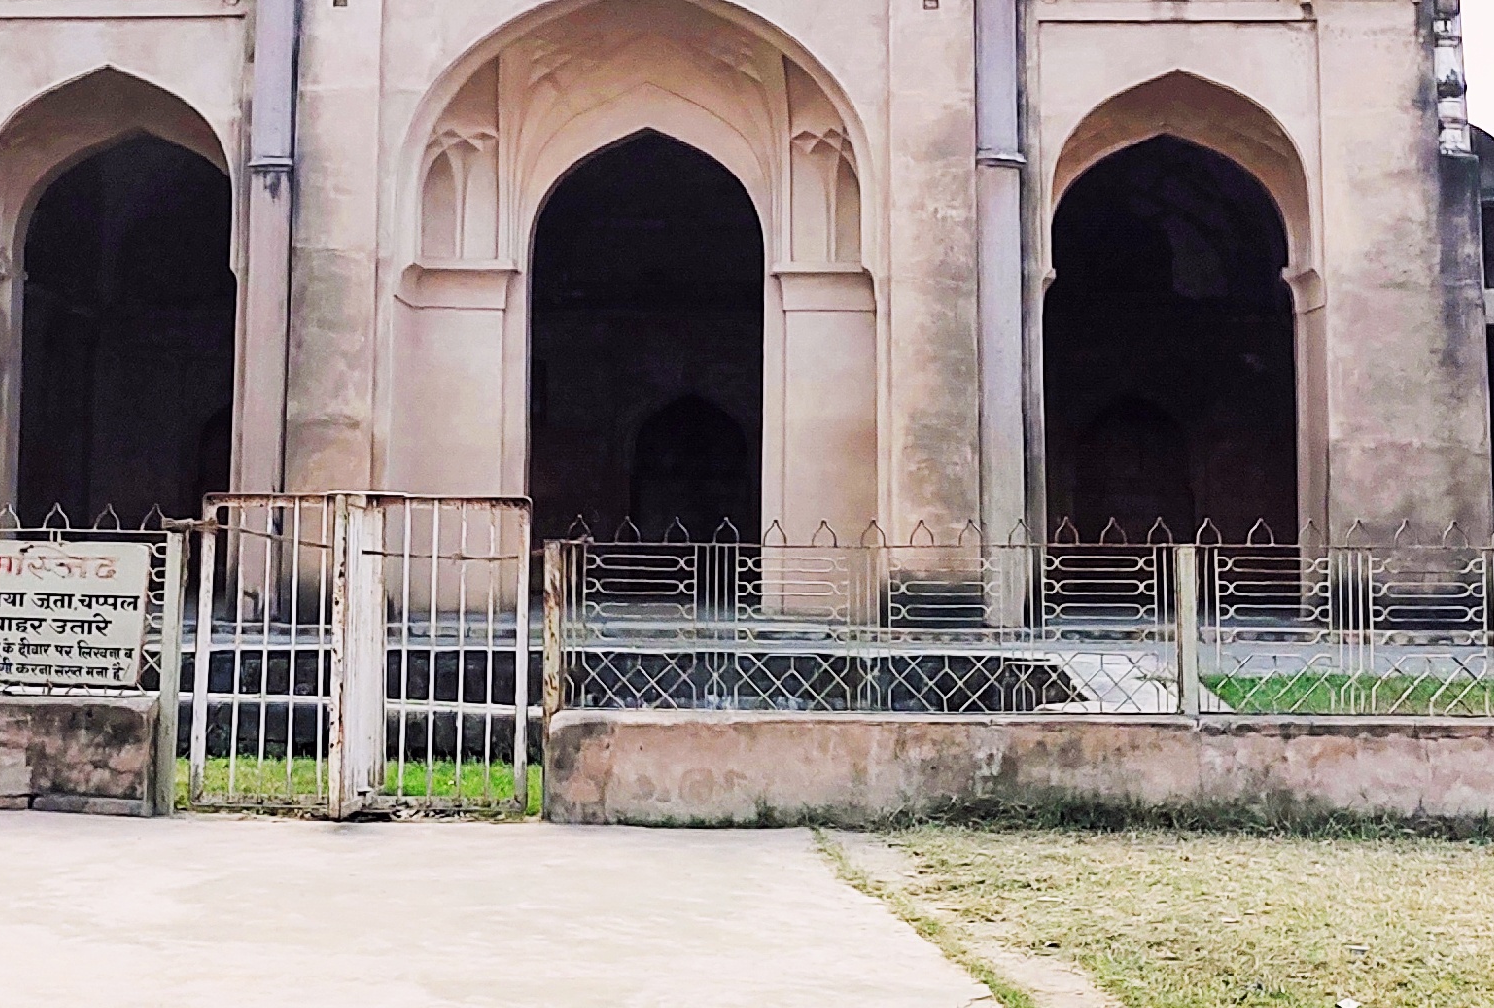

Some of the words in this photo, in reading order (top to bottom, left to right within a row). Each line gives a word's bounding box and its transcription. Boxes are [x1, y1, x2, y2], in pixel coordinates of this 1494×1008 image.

[78, 594, 140, 611] चप्पल
[49, 612, 112, 637] उतारे
[54, 644, 74, 659] पर
[15, 662, 53, 676] करना
[85, 665, 110, 679] मना
